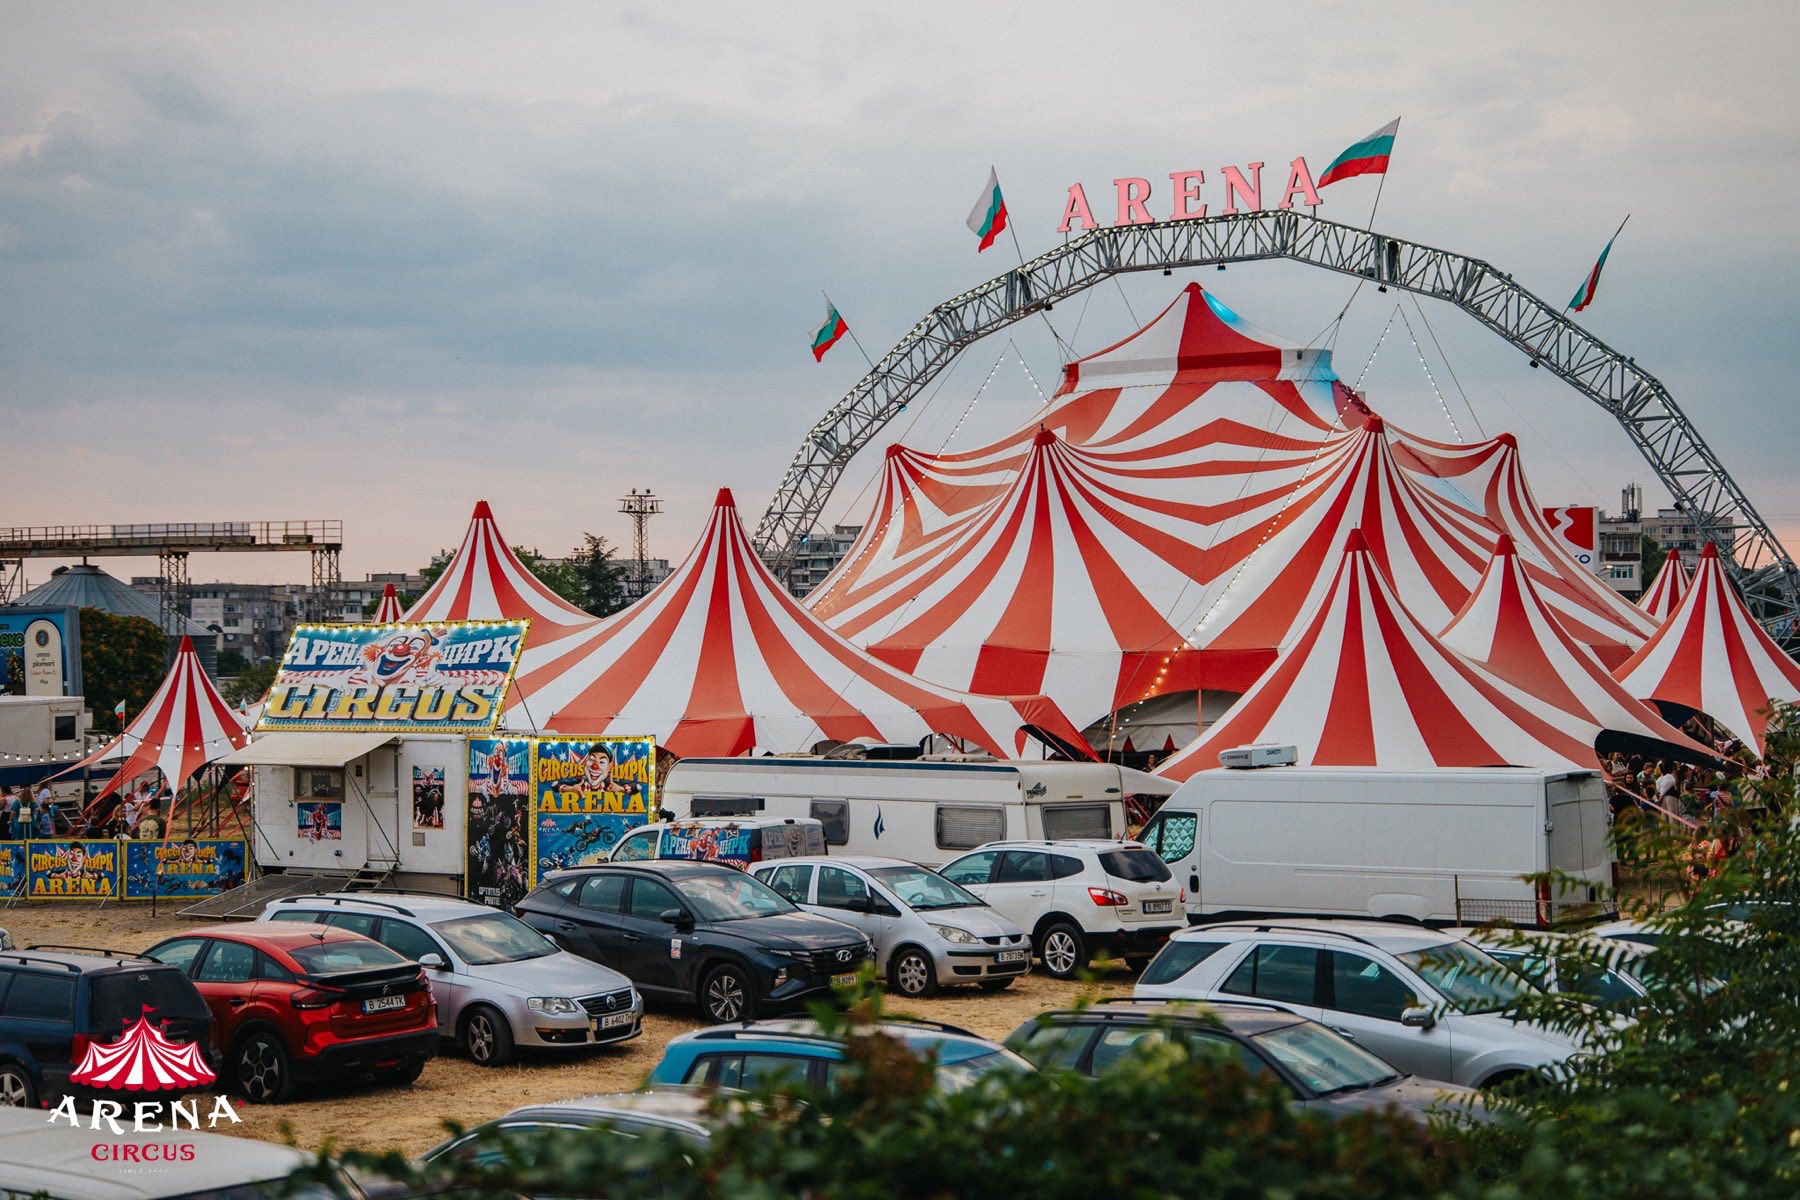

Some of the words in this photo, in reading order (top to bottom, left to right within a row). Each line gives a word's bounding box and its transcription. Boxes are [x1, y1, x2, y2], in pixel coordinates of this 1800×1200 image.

[1057, 156, 1324, 233] ARENA
[285, 637, 364, 666] АРЕНА
[443, 634, 521, 667] ЦИРК
[268, 683, 498, 722] CIRCUS
[538, 758, 585, 784] CIRCUS
[611, 758, 648, 783] ЦИРК
[537, 790, 647, 813] ARENA
[719, 834, 750, 857] ЦИРК
[31, 853, 67, 873] CIRCUS
[85, 851, 114, 873] ЦИРК
[155, 863, 215, 875] ARENA
[32, 878, 113, 895] ARENA
[479, 886, 501, 896] OPTIMUS
[485, 896, 501, 905] PRIME
[378, 998, 395, 1008] 2544
